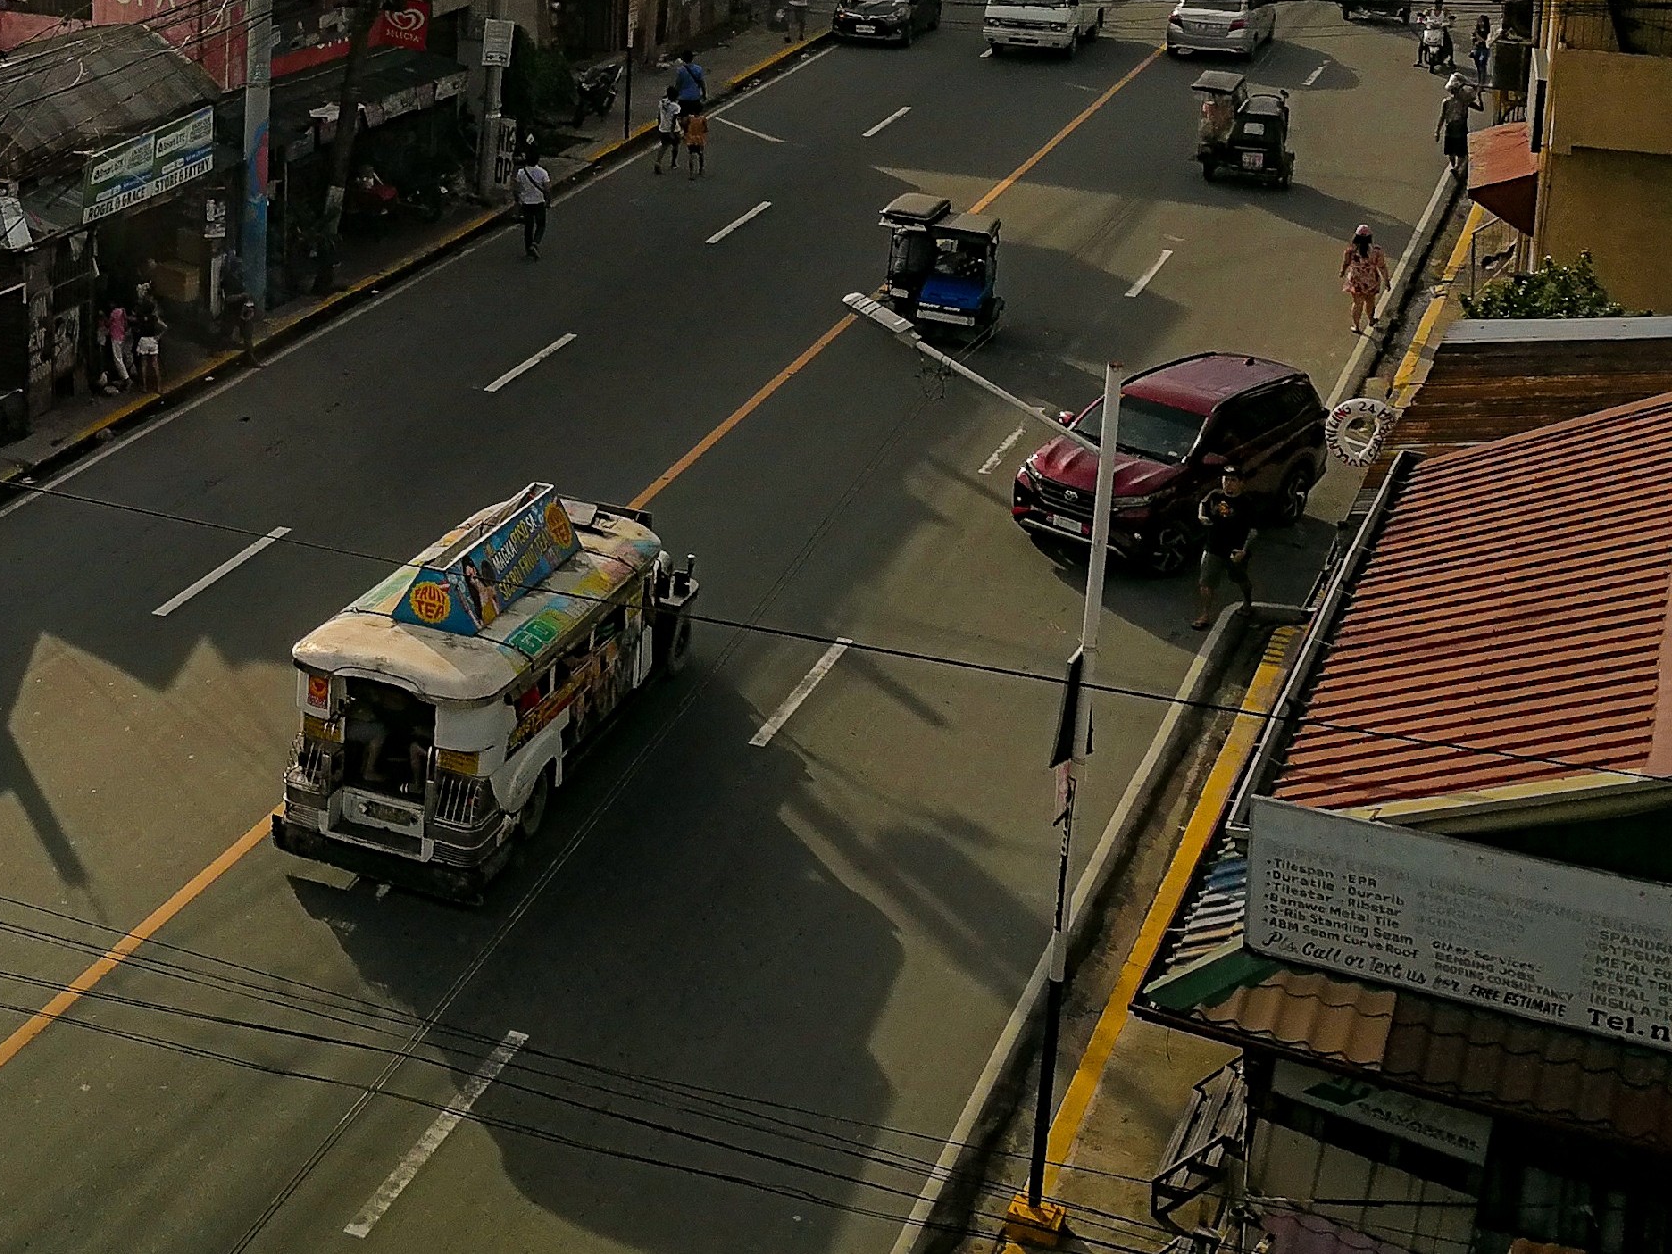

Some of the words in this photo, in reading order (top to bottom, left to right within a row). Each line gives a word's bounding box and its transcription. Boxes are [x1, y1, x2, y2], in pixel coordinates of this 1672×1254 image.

[416, 584, 447, 600] FRUIT
[417, 599, 446, 620] TEA
[1301, 941, 1342, 963] Call
[1369, 956, 1403, 980] Text
[1468, 983, 1500, 1002] FREE
[1502, 991, 1568, 1018] ESTIMATE
[1587, 1007, 1644, 1036] Tel.
